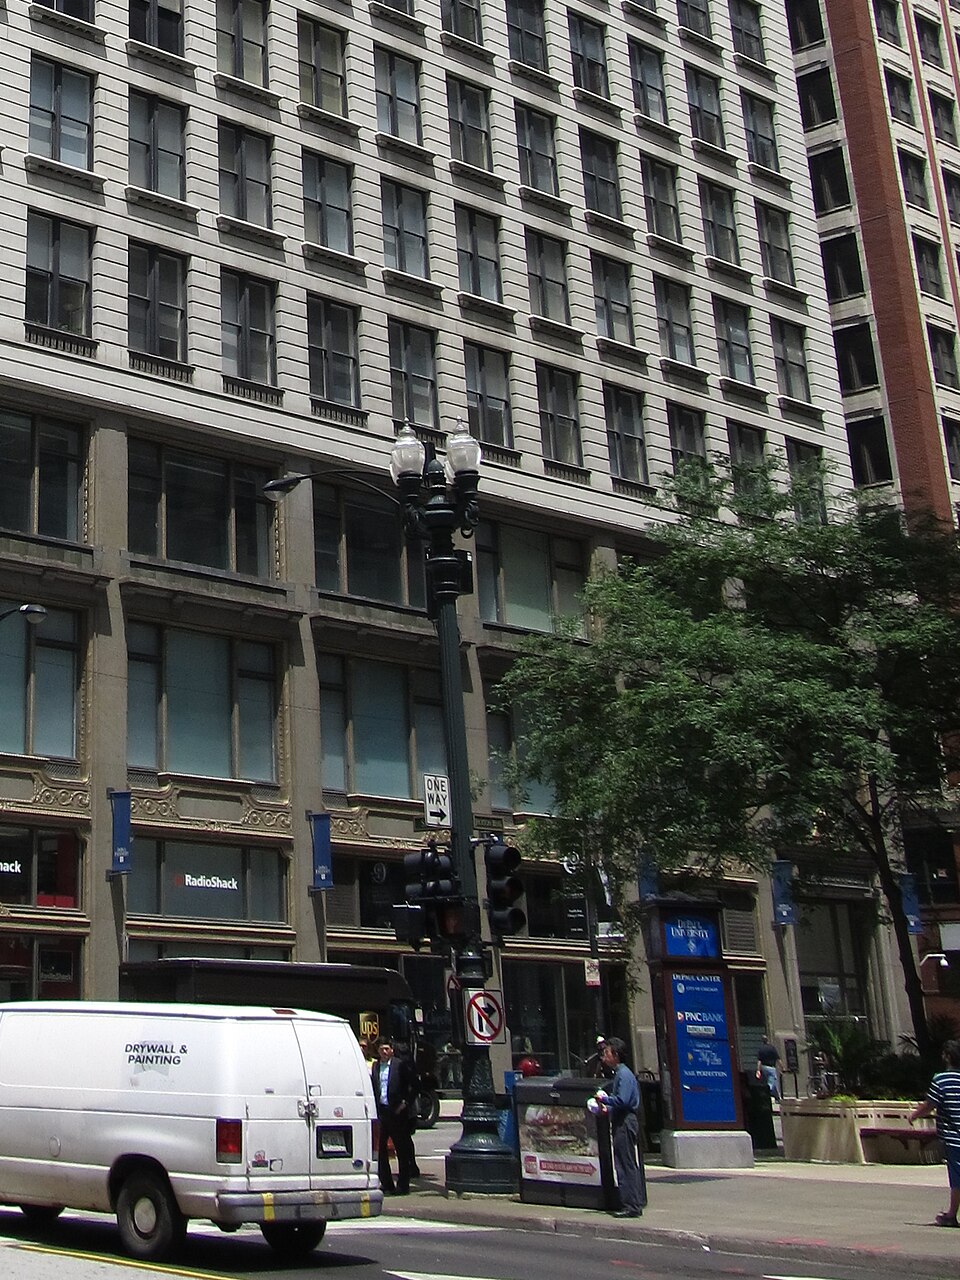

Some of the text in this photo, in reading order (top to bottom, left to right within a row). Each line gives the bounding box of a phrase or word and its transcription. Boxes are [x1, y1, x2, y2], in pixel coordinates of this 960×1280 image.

[427, 778, 446, 792] ONE
[427, 793, 447, 806] WAY
[185, 874, 238, 890] RadioShack
[671, 927, 709, 939] UNIVERSITY
[361, 1023, 378, 1040] ups
[125, 1044, 188, 1054] DRYWALL &
[128, 1055, 181, 1065] PAINTING
